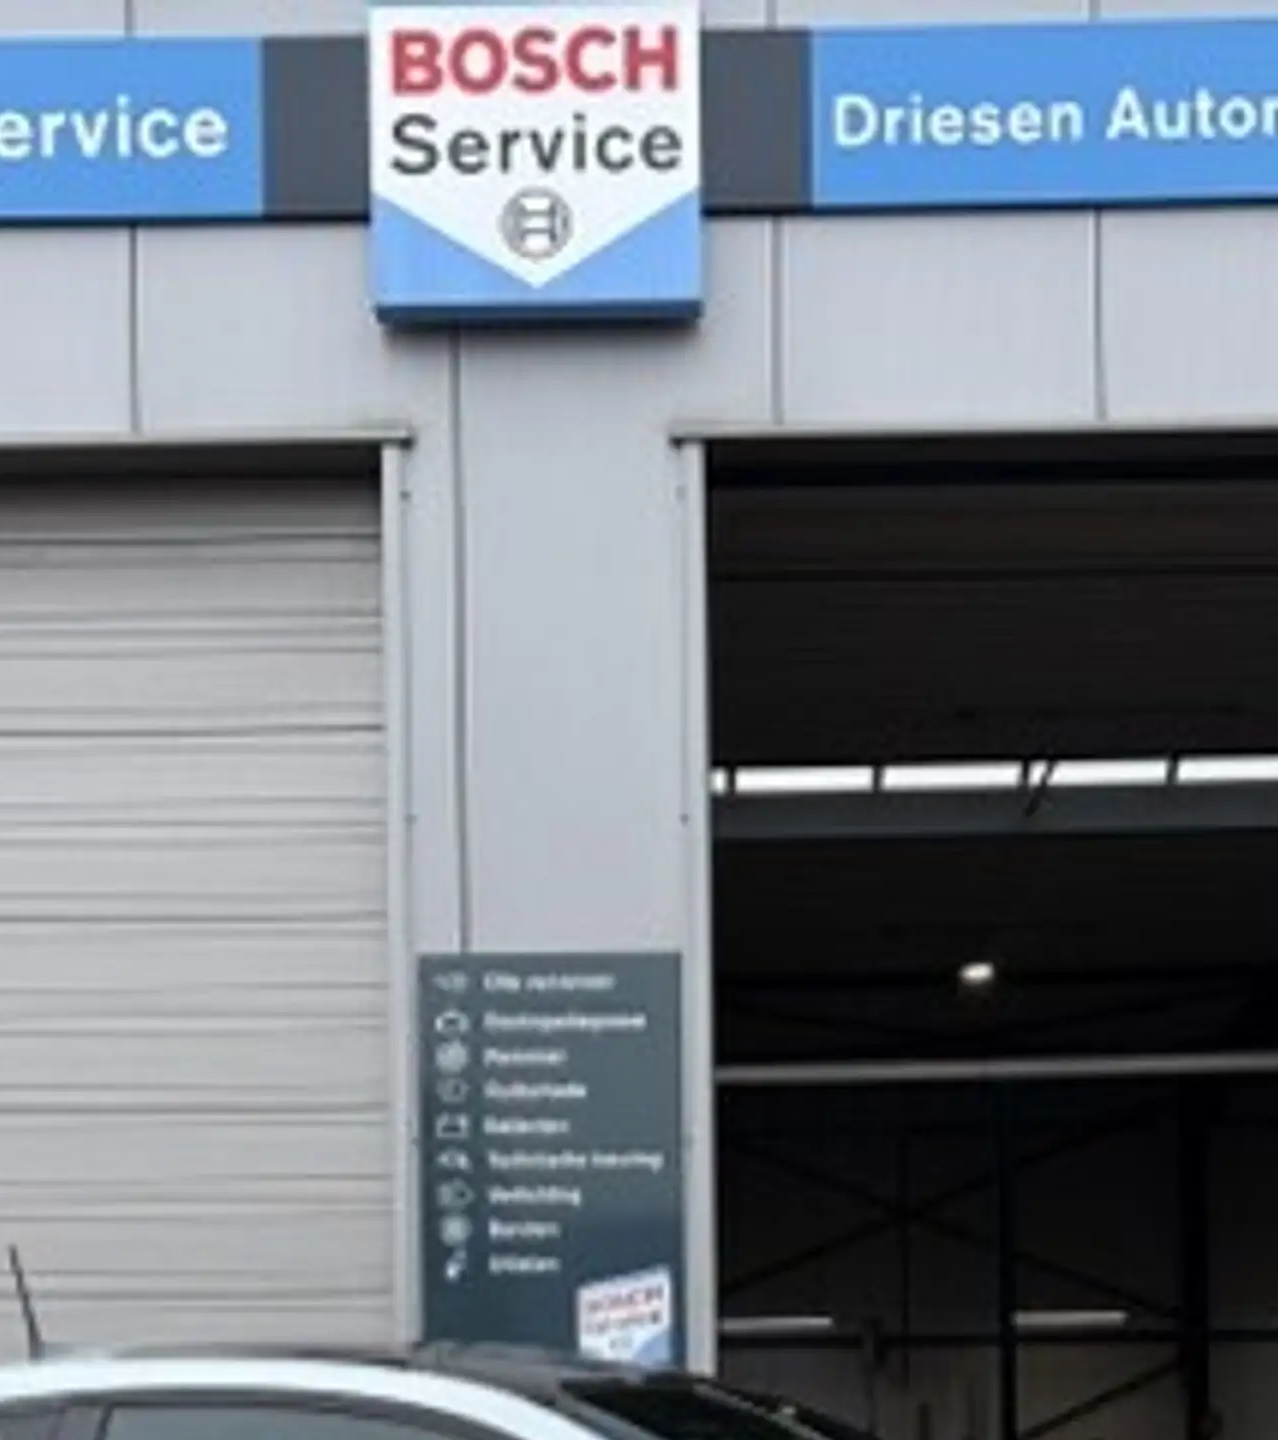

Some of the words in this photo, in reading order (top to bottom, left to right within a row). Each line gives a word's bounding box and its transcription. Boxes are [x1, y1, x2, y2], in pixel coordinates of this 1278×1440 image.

[389, 27, 679, 95] BOSCH
[391, 113, 682, 175] Service
[833, 94, 1082, 146] Driesen
